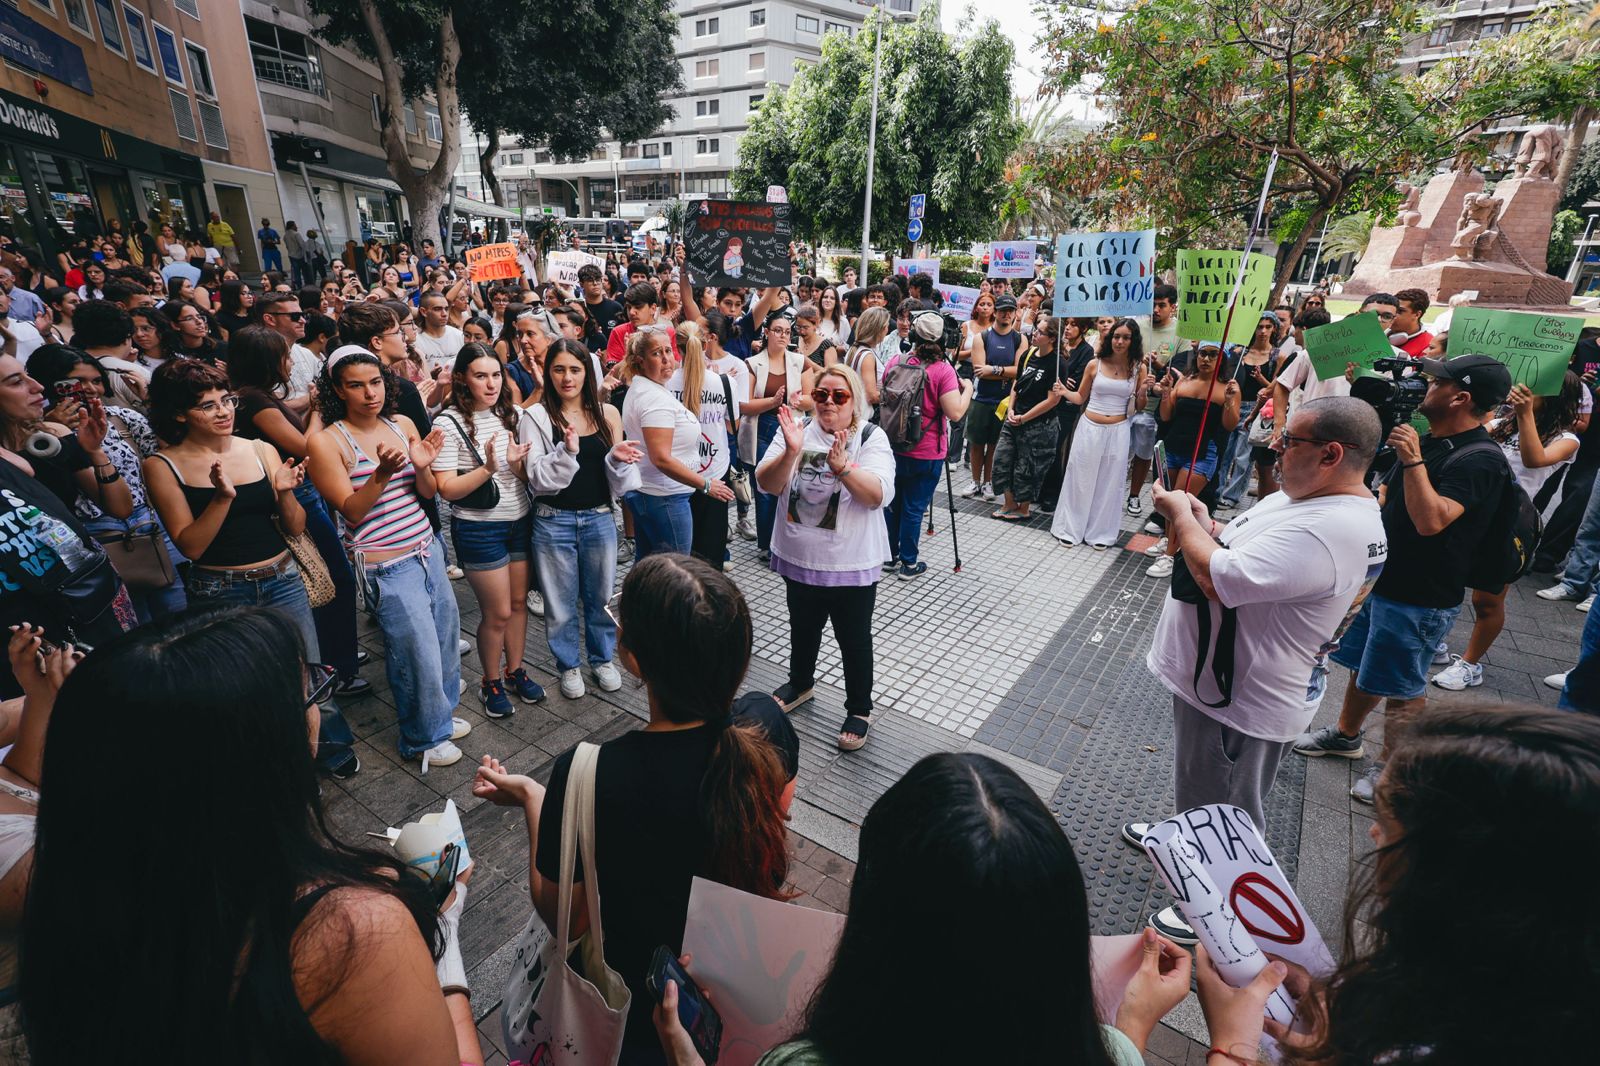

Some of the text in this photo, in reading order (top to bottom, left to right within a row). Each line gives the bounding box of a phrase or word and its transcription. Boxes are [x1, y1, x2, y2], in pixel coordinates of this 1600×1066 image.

[469, 251, 482, 263] NO
[1324, 326, 1354, 342] Burla
[1462, 318, 1506, 345] Todos
